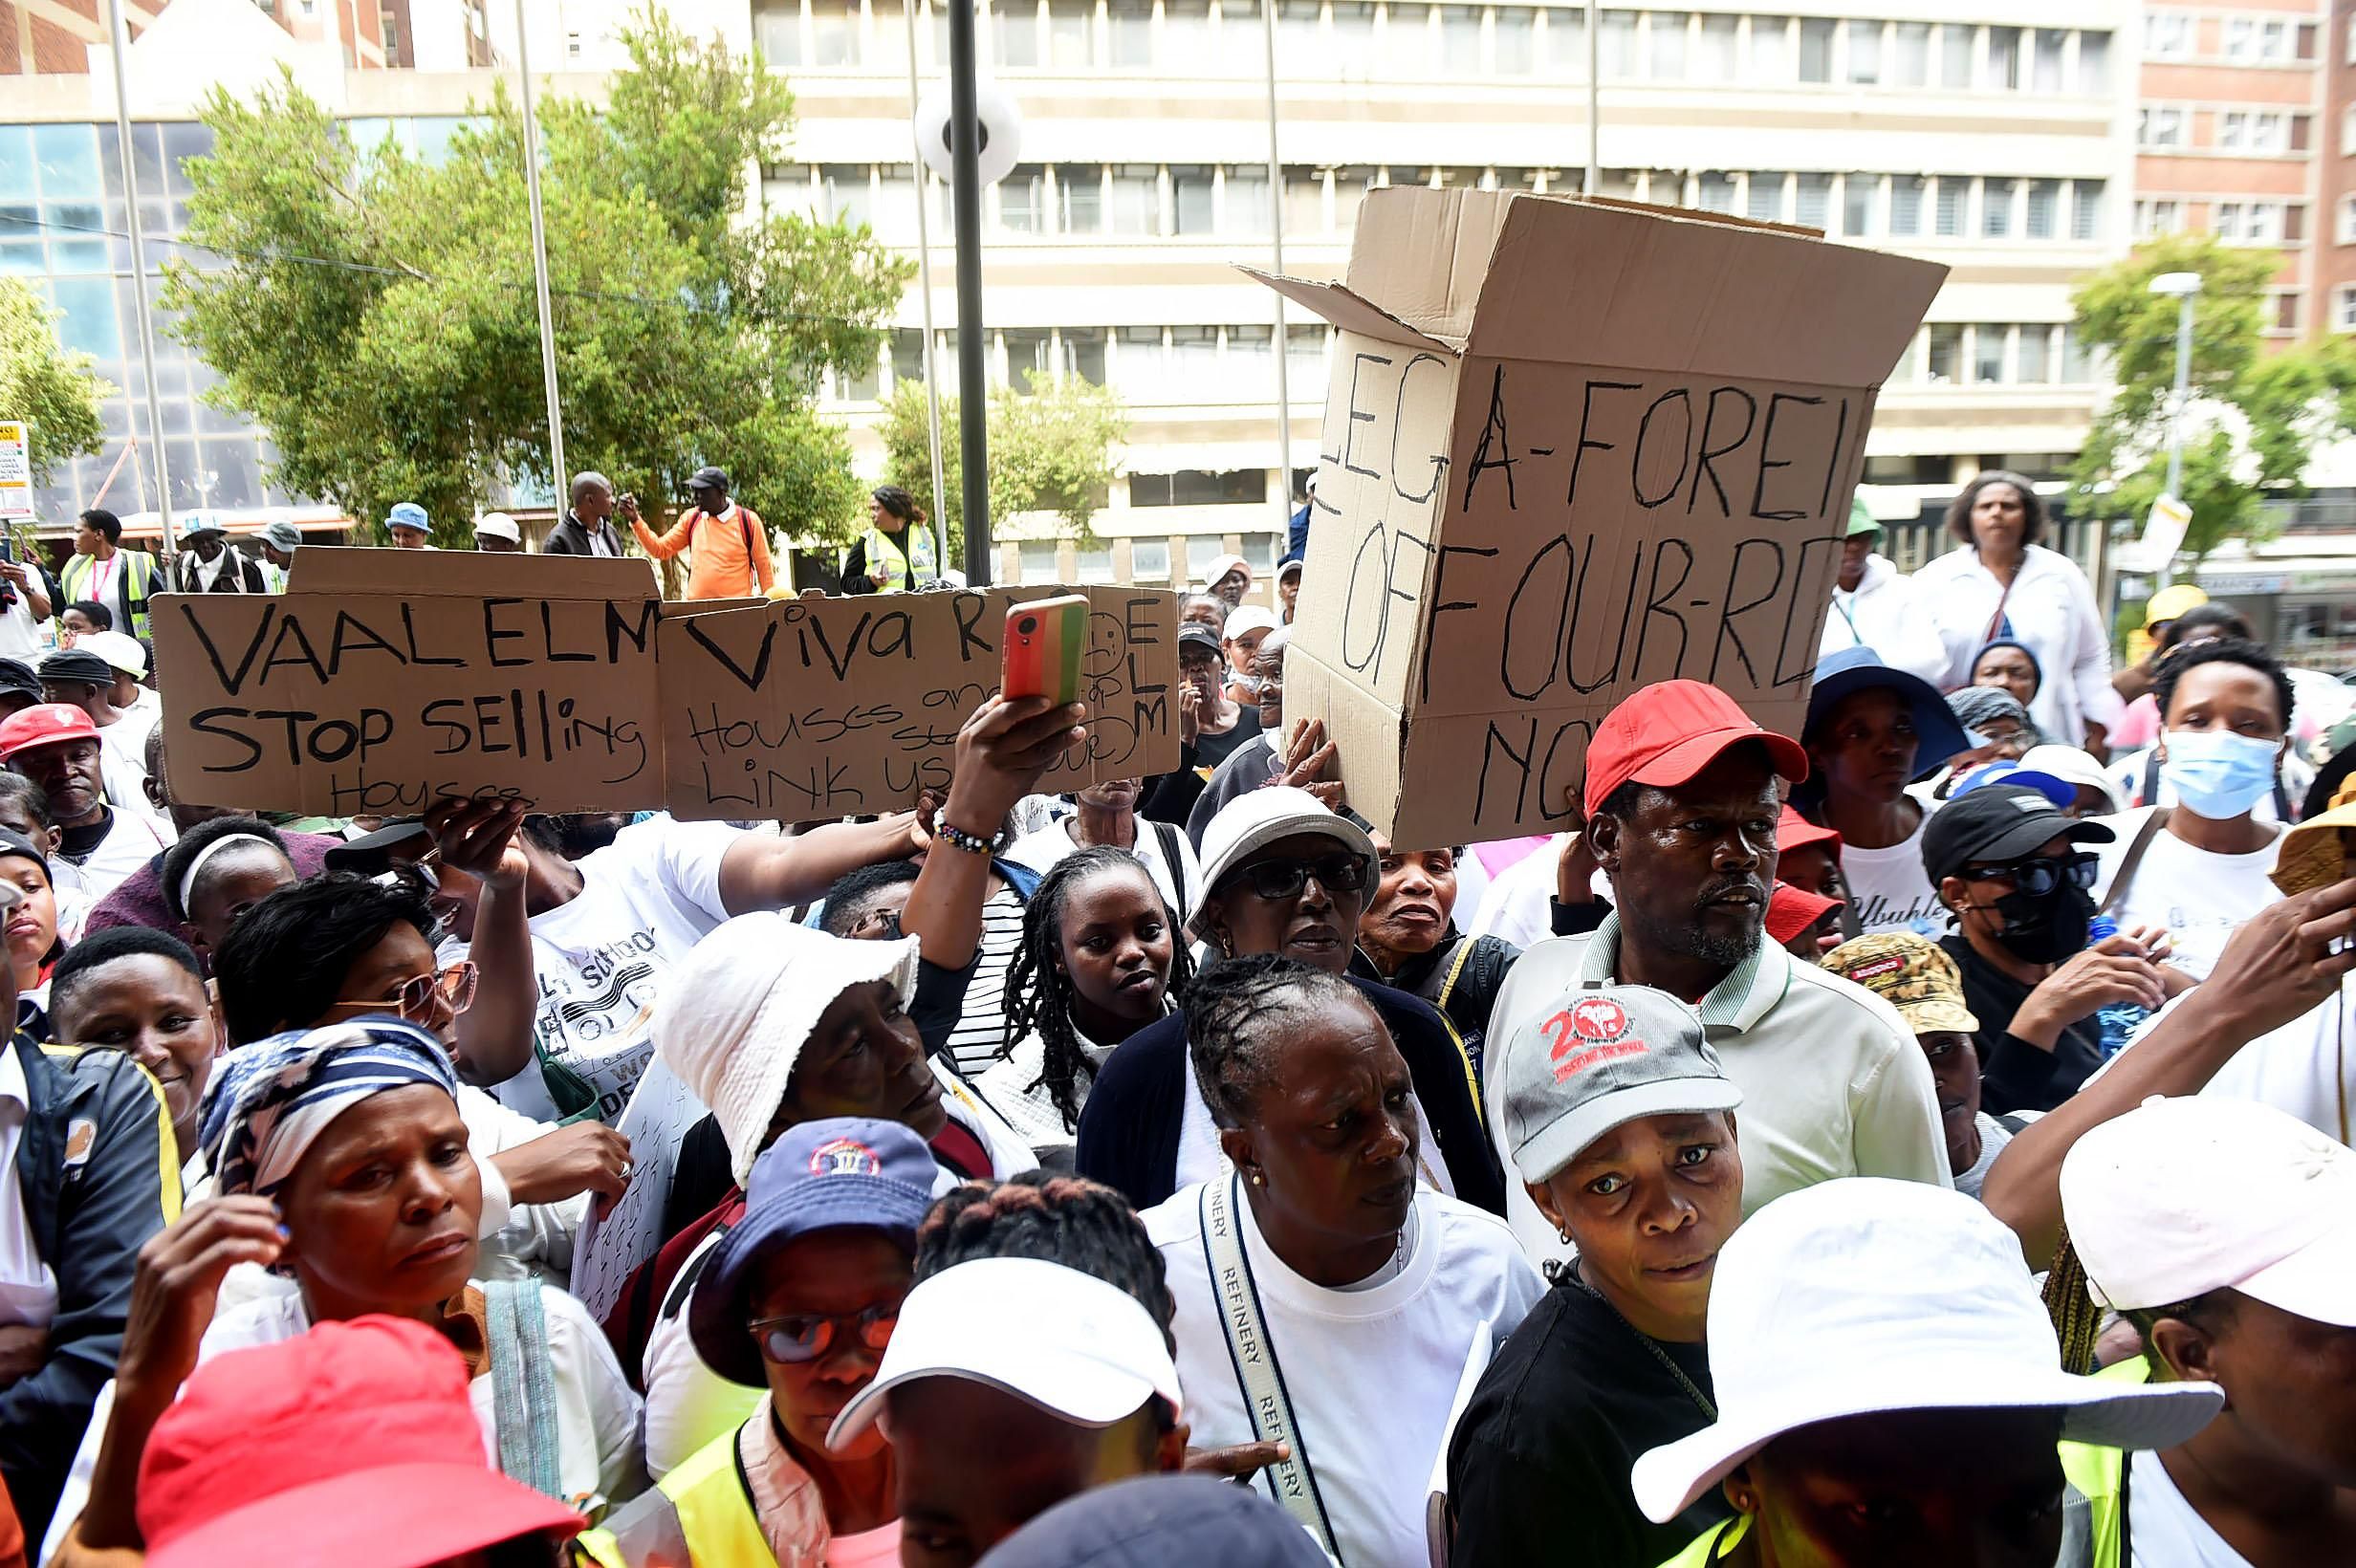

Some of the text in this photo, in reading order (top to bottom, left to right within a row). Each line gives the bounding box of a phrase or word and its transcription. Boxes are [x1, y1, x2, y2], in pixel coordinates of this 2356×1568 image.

[180, 598, 660, 696] VAAL ELM
[188, 706, 394, 773] STOP
[579, 926, 656, 990] SCHOO
[1222, 1267, 1262, 1366] REFINERY
[1258, 1395, 1305, 1499] REFIERY
